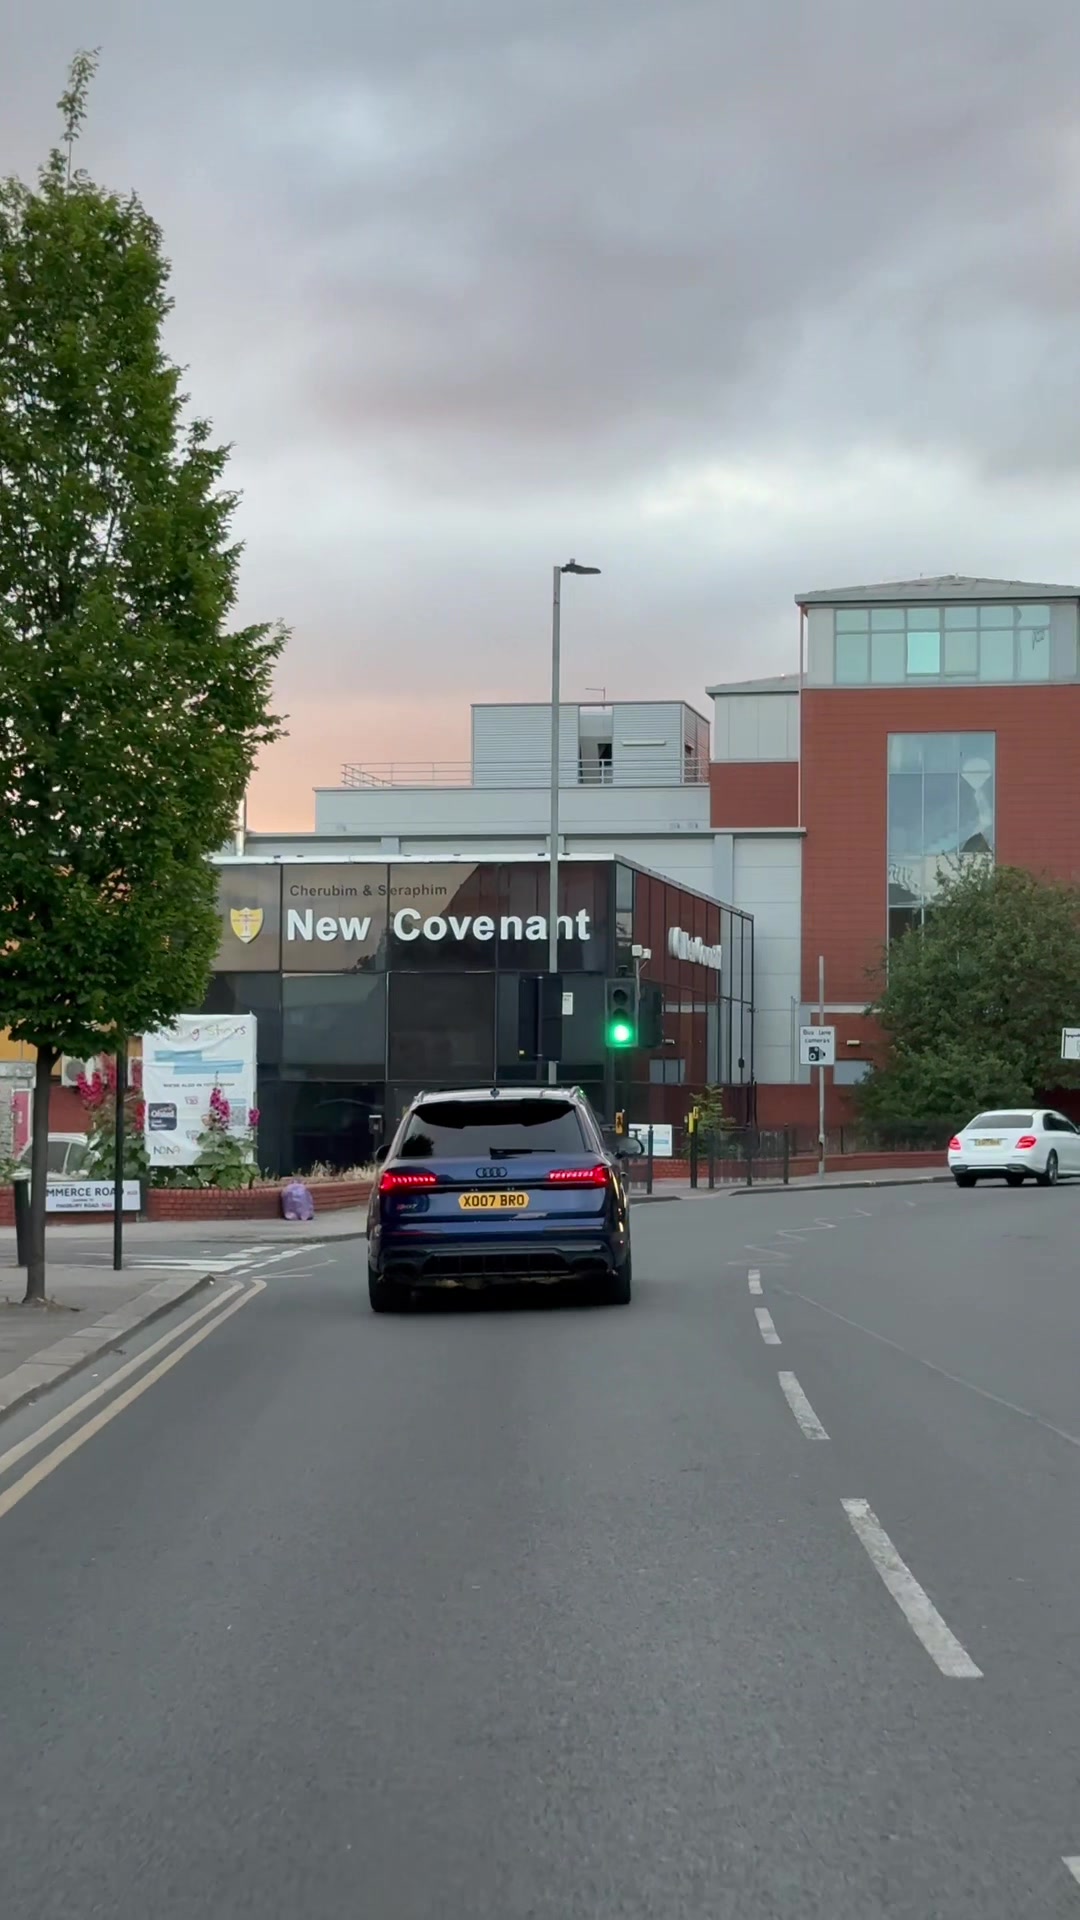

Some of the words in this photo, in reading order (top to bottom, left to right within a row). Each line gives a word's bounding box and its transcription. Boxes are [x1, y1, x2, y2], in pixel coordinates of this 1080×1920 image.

[289, 884, 358, 897] Cherubim
[363, 884, 373, 897] &
[378, 884, 448, 899] Seraphim
[287, 908, 372, 941] New
[393, 907, 591, 941] Covenant
[47, 1187, 91, 1197] MMERCE
[94, 1187, 124, 1196] ROA
[500, 1194, 525, 1207] BRO
